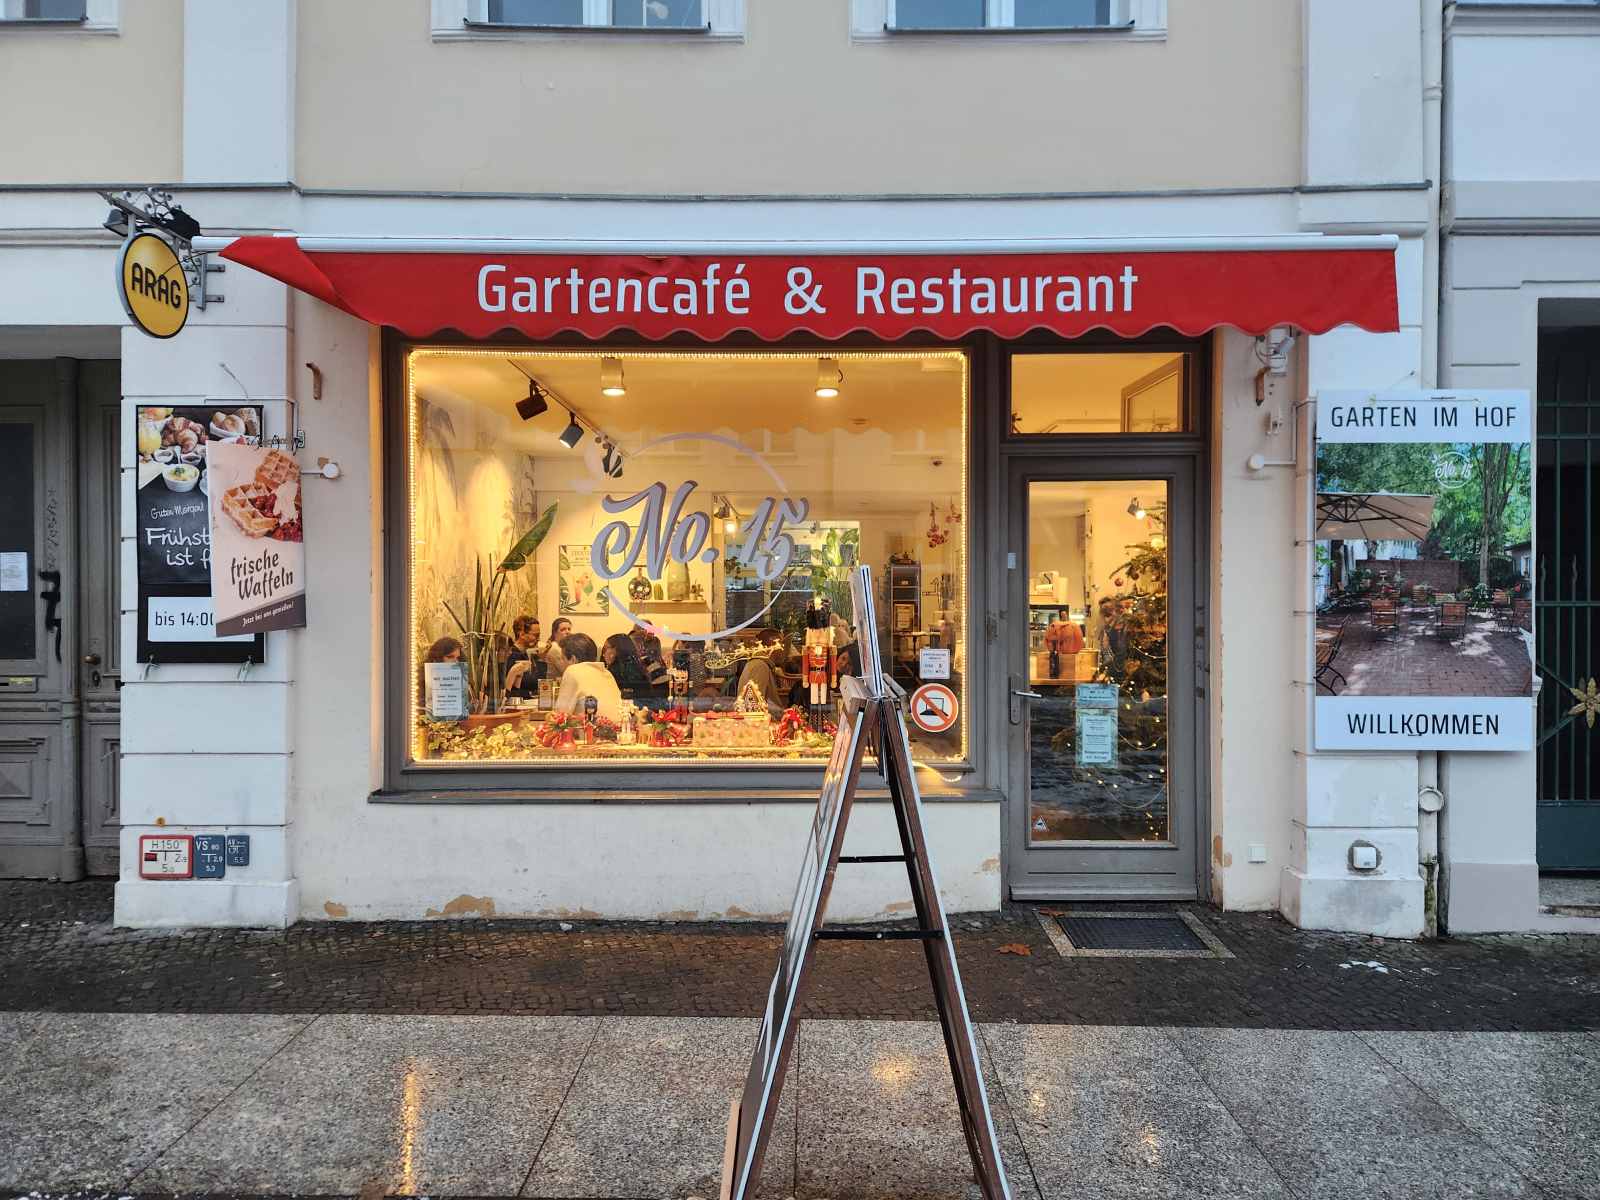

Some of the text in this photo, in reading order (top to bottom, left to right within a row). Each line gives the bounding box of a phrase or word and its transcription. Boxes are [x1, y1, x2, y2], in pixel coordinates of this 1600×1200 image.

[131, 262, 181, 309] ARAG
[477, 263, 1139, 315] Gartencafé & Restaurant
[1331, 406, 1517, 428] GARTEN IM HOF
[591, 480, 809, 581] No. 15
[166, 547, 194, 566] ist
[231, 548, 279, 585] frische
[239, 567, 293, 600] Waffeln
[155, 611, 175, 626] bis
[1347, 713, 1499, 735] WILLKOMMEN
